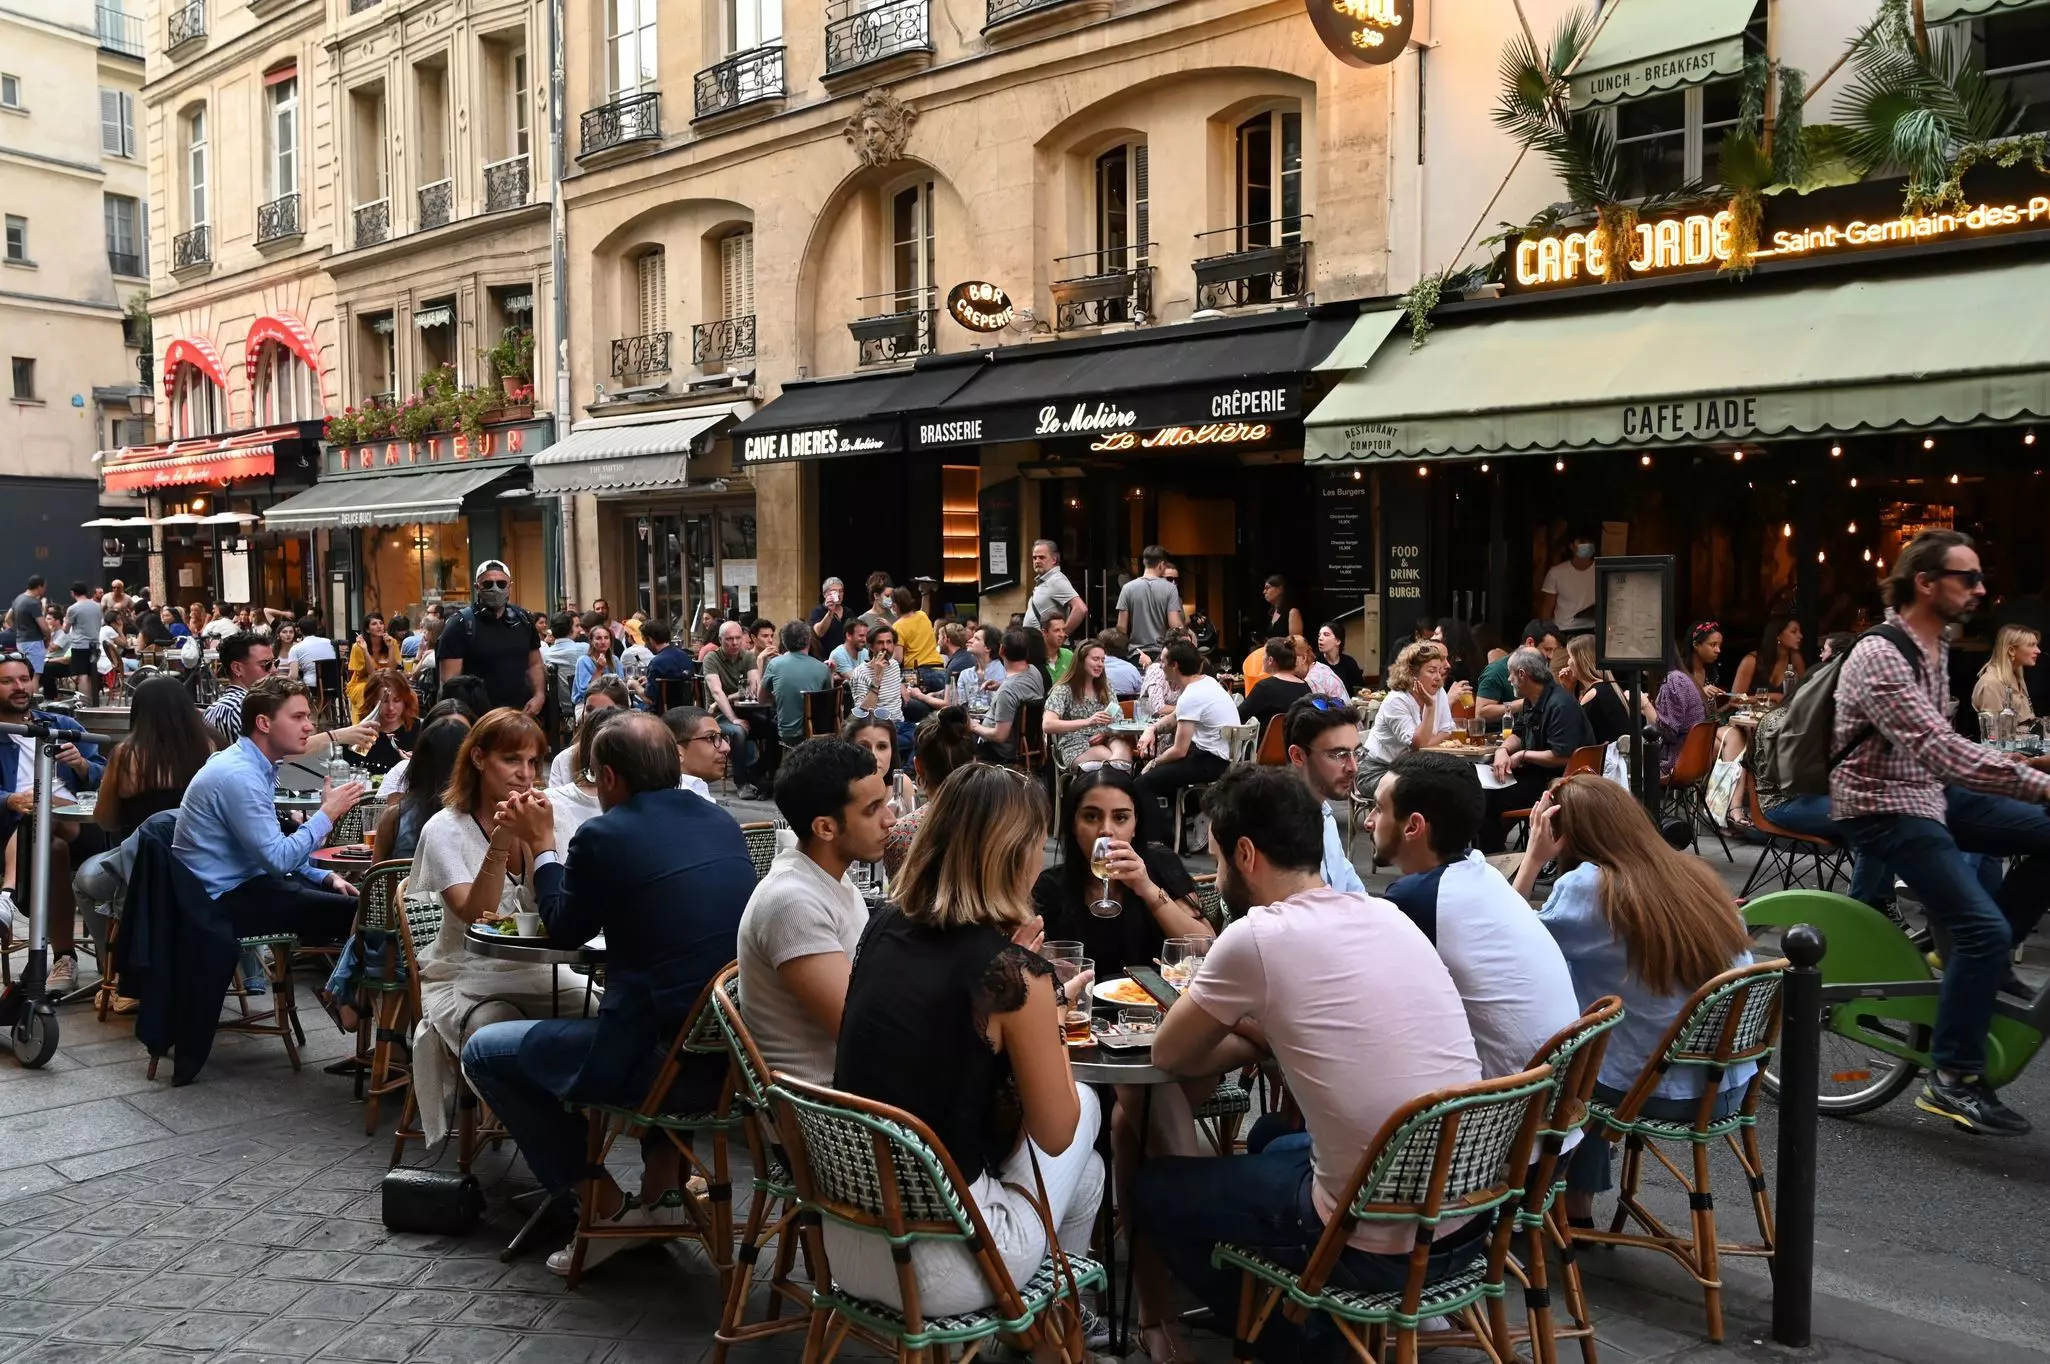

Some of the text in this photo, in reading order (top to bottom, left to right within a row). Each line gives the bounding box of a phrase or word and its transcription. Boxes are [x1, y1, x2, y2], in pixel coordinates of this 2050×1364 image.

[1591, 72, 1630, 94] LUNCH
[1645, 51, 1716, 82] BREAKFAST
[1628, 210, 1735, 272] JADE
[506, 295, 526, 309] SALON
[957, 298, 1015, 328] CREPERIE
[1211, 388, 1286, 417] CRÊPERIE
[1035, 402, 1136, 434] Le Molière
[1623, 397, 1756, 436] CAFE JADE
[920, 419, 982, 444] BRASSERIE
[1090, 431, 1135, 451] Le
[1344, 424, 1398, 439] RESTAURANT
[339, 430, 523, 470] TRAITEUR
[745, 435, 777, 461] CAVE
[779, 433, 789, 458] A
[791, 428, 838, 457] BIERES
[1350, 439, 1392, 451] COMPTOIR
[1322, 487, 1366, 497] Les Burgers
[1391, 546, 1418, 557] FOOD
[1401, 558, 1409, 567] &
[1390, 568, 1421, 580] DRINK
[1389, 586, 1421, 598] BURGER
